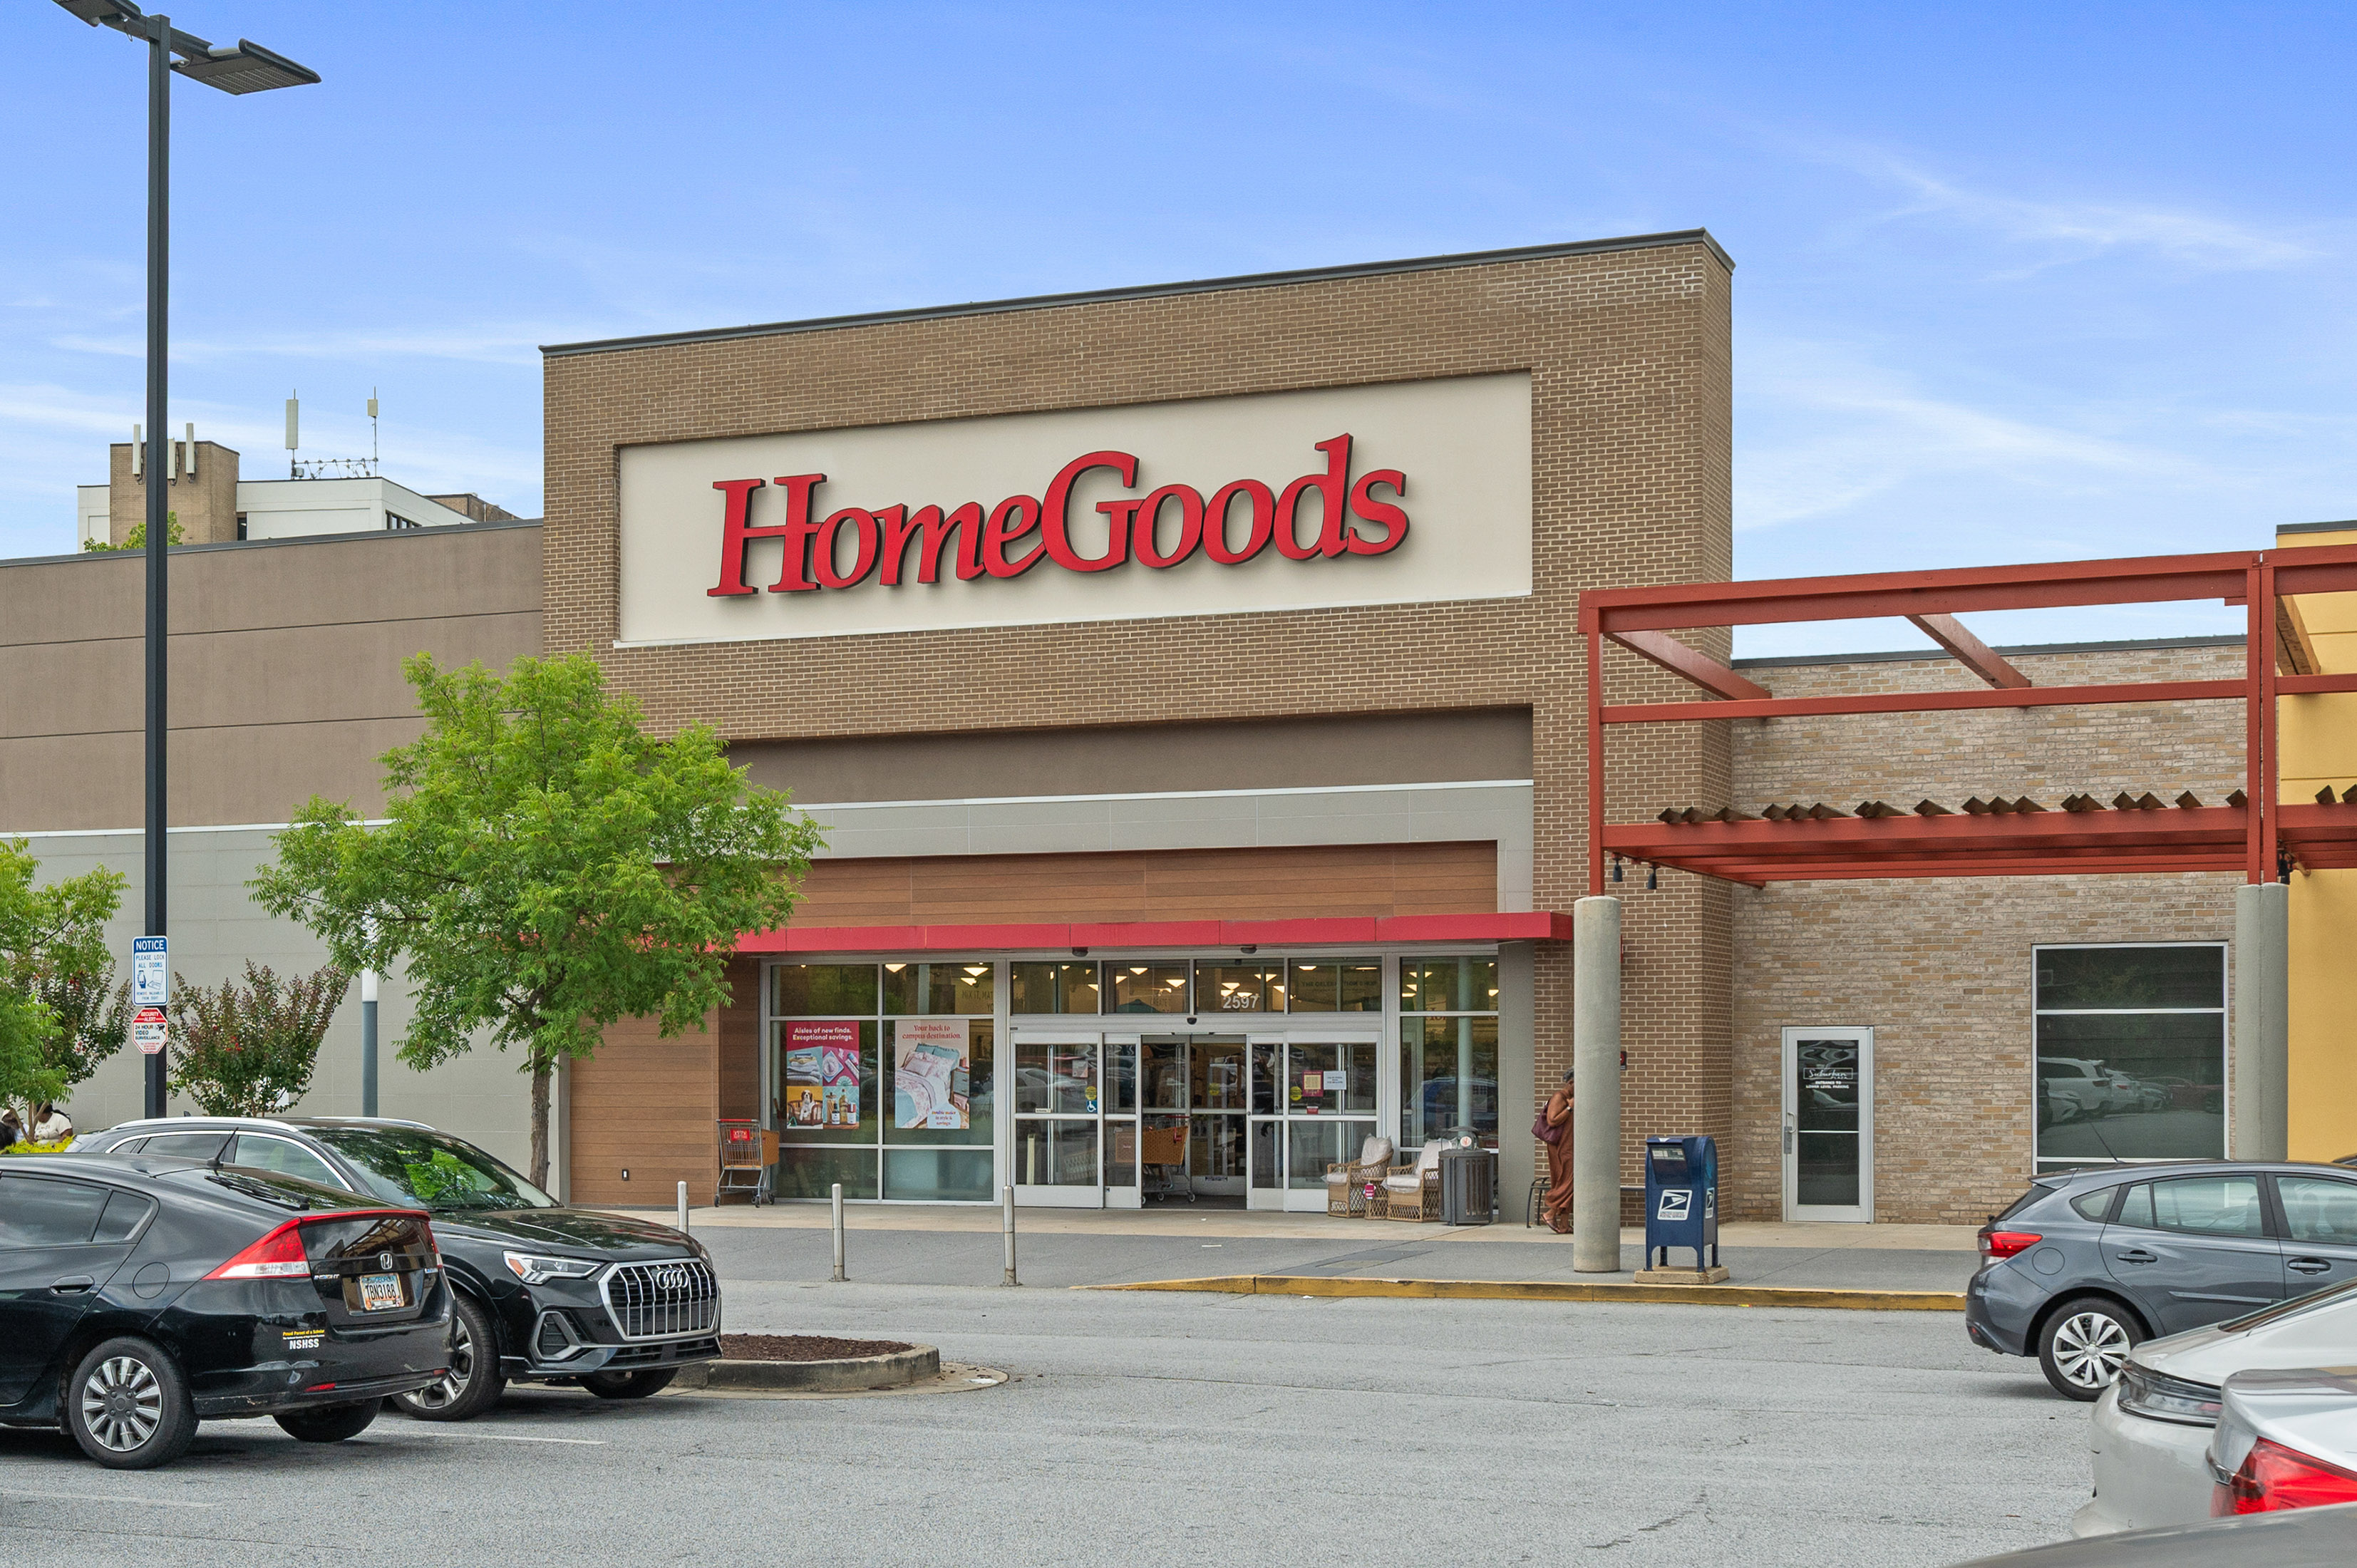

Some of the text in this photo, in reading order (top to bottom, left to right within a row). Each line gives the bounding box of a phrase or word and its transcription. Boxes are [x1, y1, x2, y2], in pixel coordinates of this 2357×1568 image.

[706, 433, 1410, 597] HomeGoods
[136, 940, 164, 951] NOTICE
[1222, 996, 1260, 1009] 2597
[1809, 1069, 1847, 1078] Suburban
[365, 1284, 396, 1300] TBN3188
[289, 1339, 319, 1349] NSHSS
